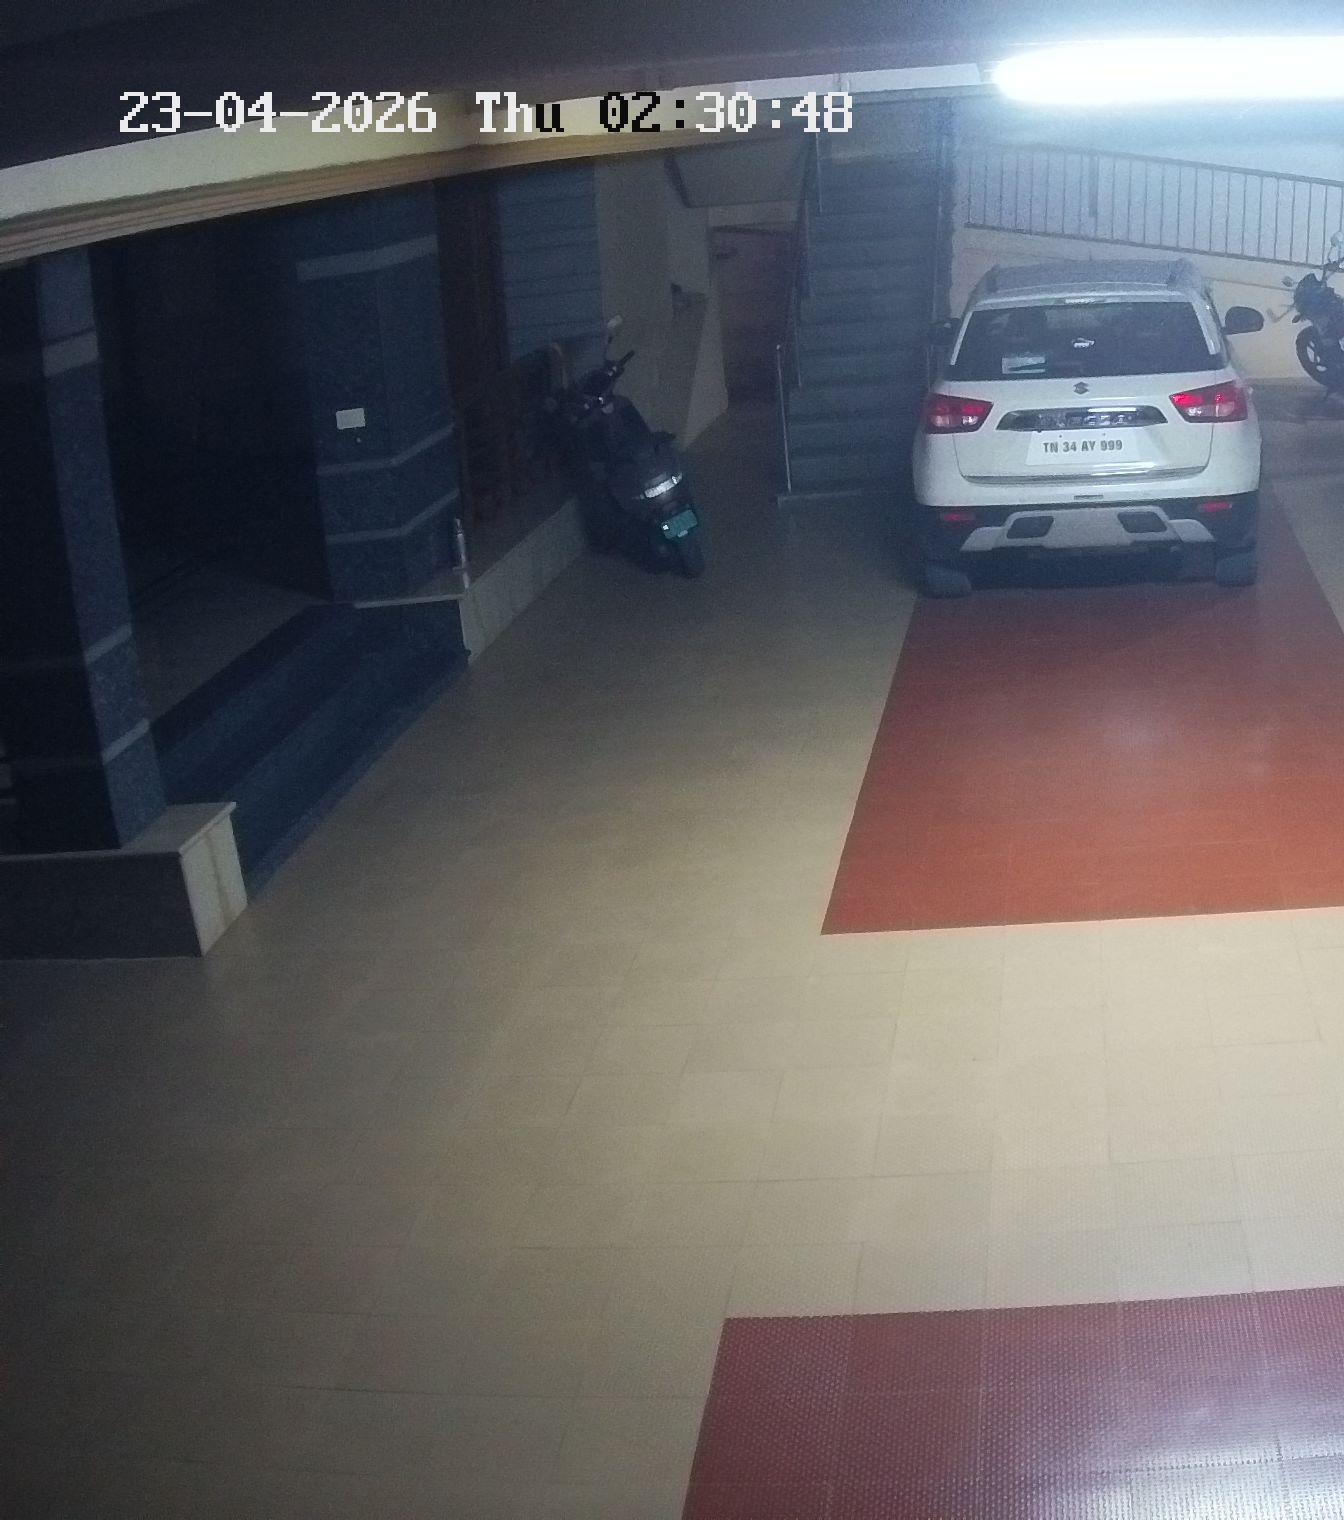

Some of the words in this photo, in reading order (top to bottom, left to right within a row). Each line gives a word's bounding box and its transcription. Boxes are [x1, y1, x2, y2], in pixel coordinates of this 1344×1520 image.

[1042, 442, 1059, 453] TN
[1063, 441, 1077, 453] 34
[1081, 440, 1096, 452] AY
